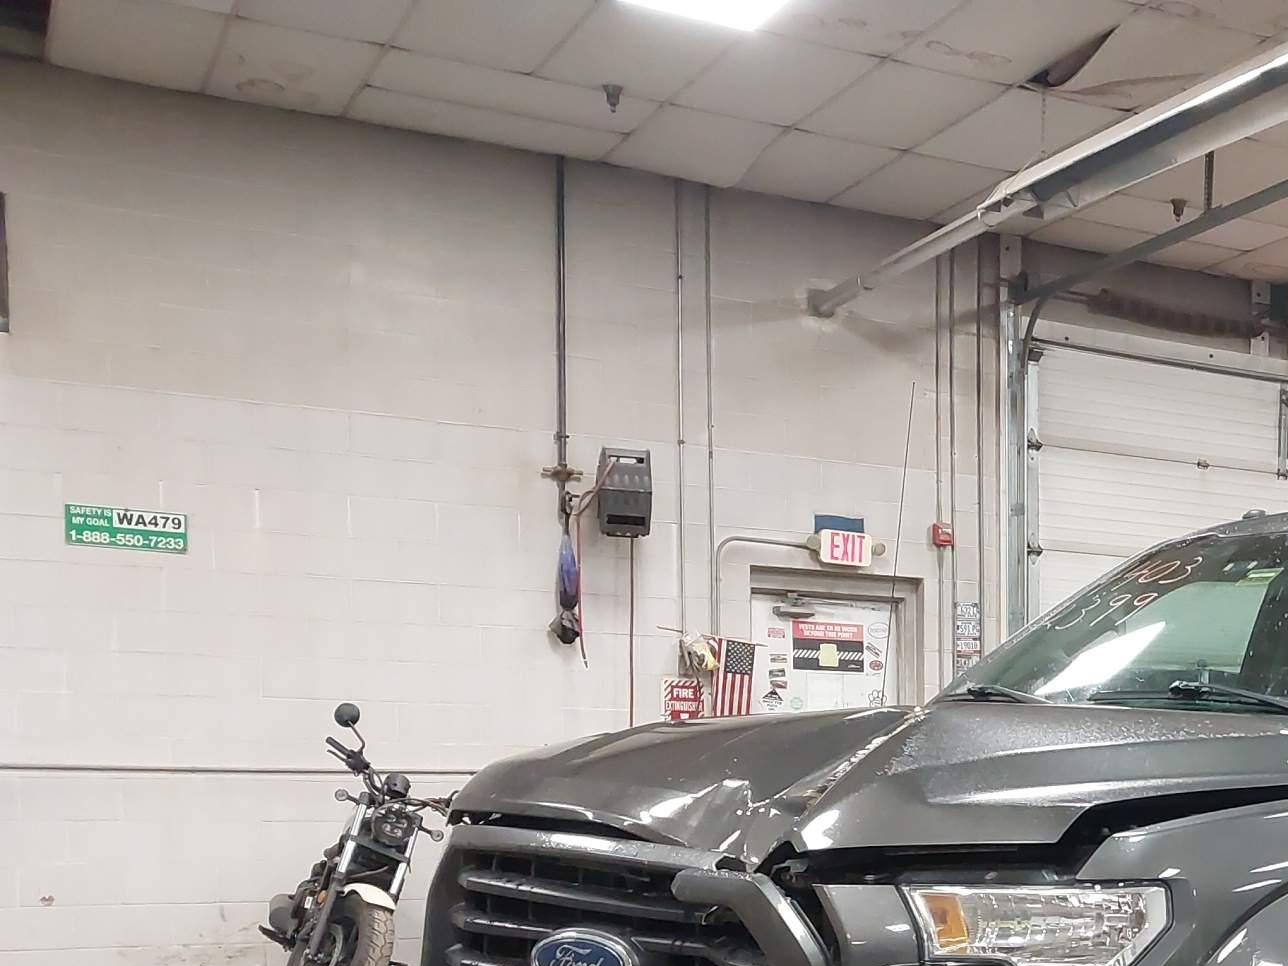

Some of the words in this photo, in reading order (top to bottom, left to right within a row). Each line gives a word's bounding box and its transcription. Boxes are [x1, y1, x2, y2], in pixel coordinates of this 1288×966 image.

[69, 506, 101, 515] SAFETY
[71, 516, 84, 525] MY
[86, 517, 110, 527] GOAL
[117, 512, 182, 530] WA479
[69, 529, 184, 549] 1-888-550-7233
[829, 531, 866, 563] EXIT
[673, 687, 695, 698] FIRE
